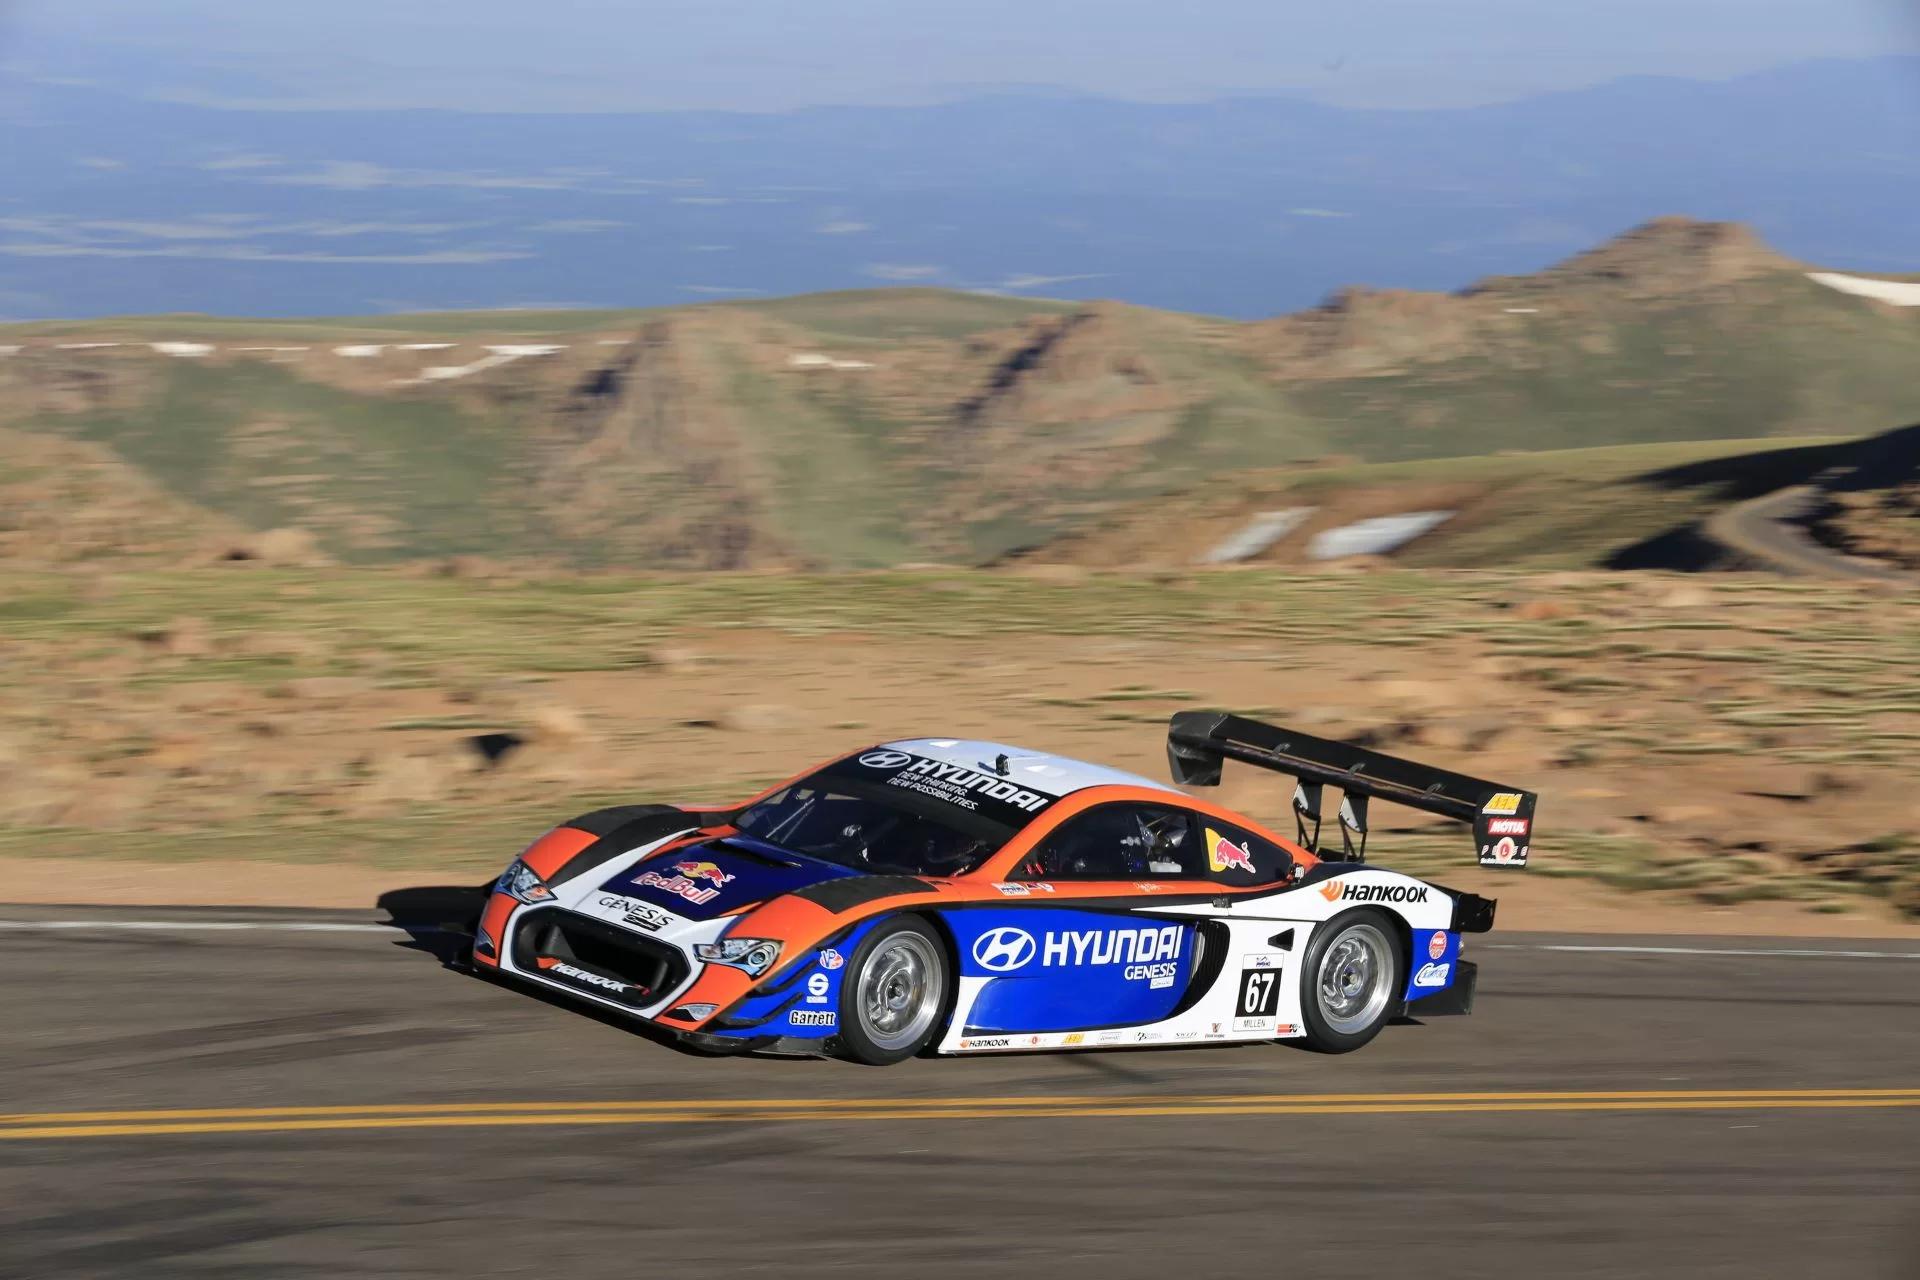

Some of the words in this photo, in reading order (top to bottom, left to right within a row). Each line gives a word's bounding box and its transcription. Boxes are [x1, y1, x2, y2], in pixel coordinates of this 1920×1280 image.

[887, 777, 913, 787] NEW
[897, 771, 923, 781] NEW
[907, 759, 1048, 812] HYUNDAI
[1490, 820, 1526, 833] MOTUL
[599, 896, 674, 926] GENESIS
[1043, 925, 1184, 966] HYUNDAI
[1124, 962, 1177, 980] GENESIS
[1245, 972, 1275, 1013] 67
[789, 1010, 836, 1026] Garrett
[1243, 1019, 1266, 1028] MILLEN
